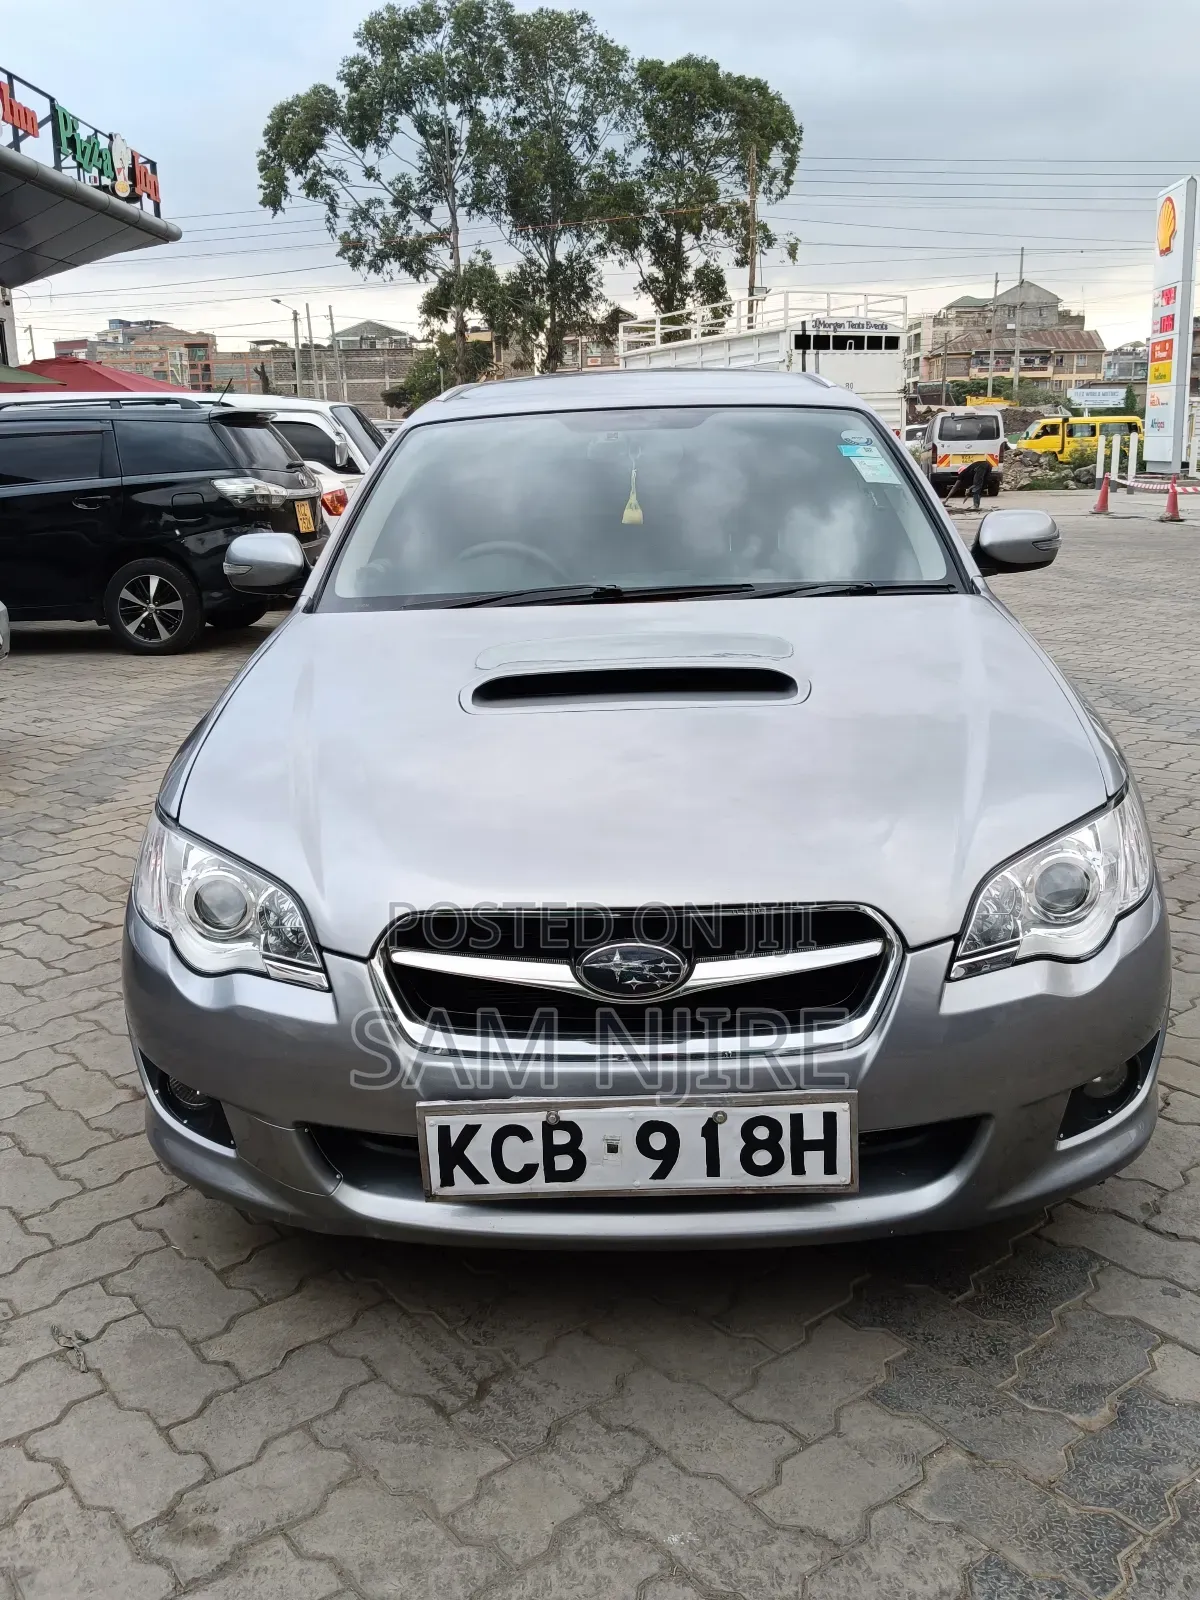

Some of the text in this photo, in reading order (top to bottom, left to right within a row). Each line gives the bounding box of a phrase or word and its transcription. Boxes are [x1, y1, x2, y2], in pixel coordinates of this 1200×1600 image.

[55, 103, 161, 203] Pizza Inn
[846, 320, 864, 330] Tents
[866, 321, 888, 331] Events
[436, 1111, 839, 1187] KCB 918H
